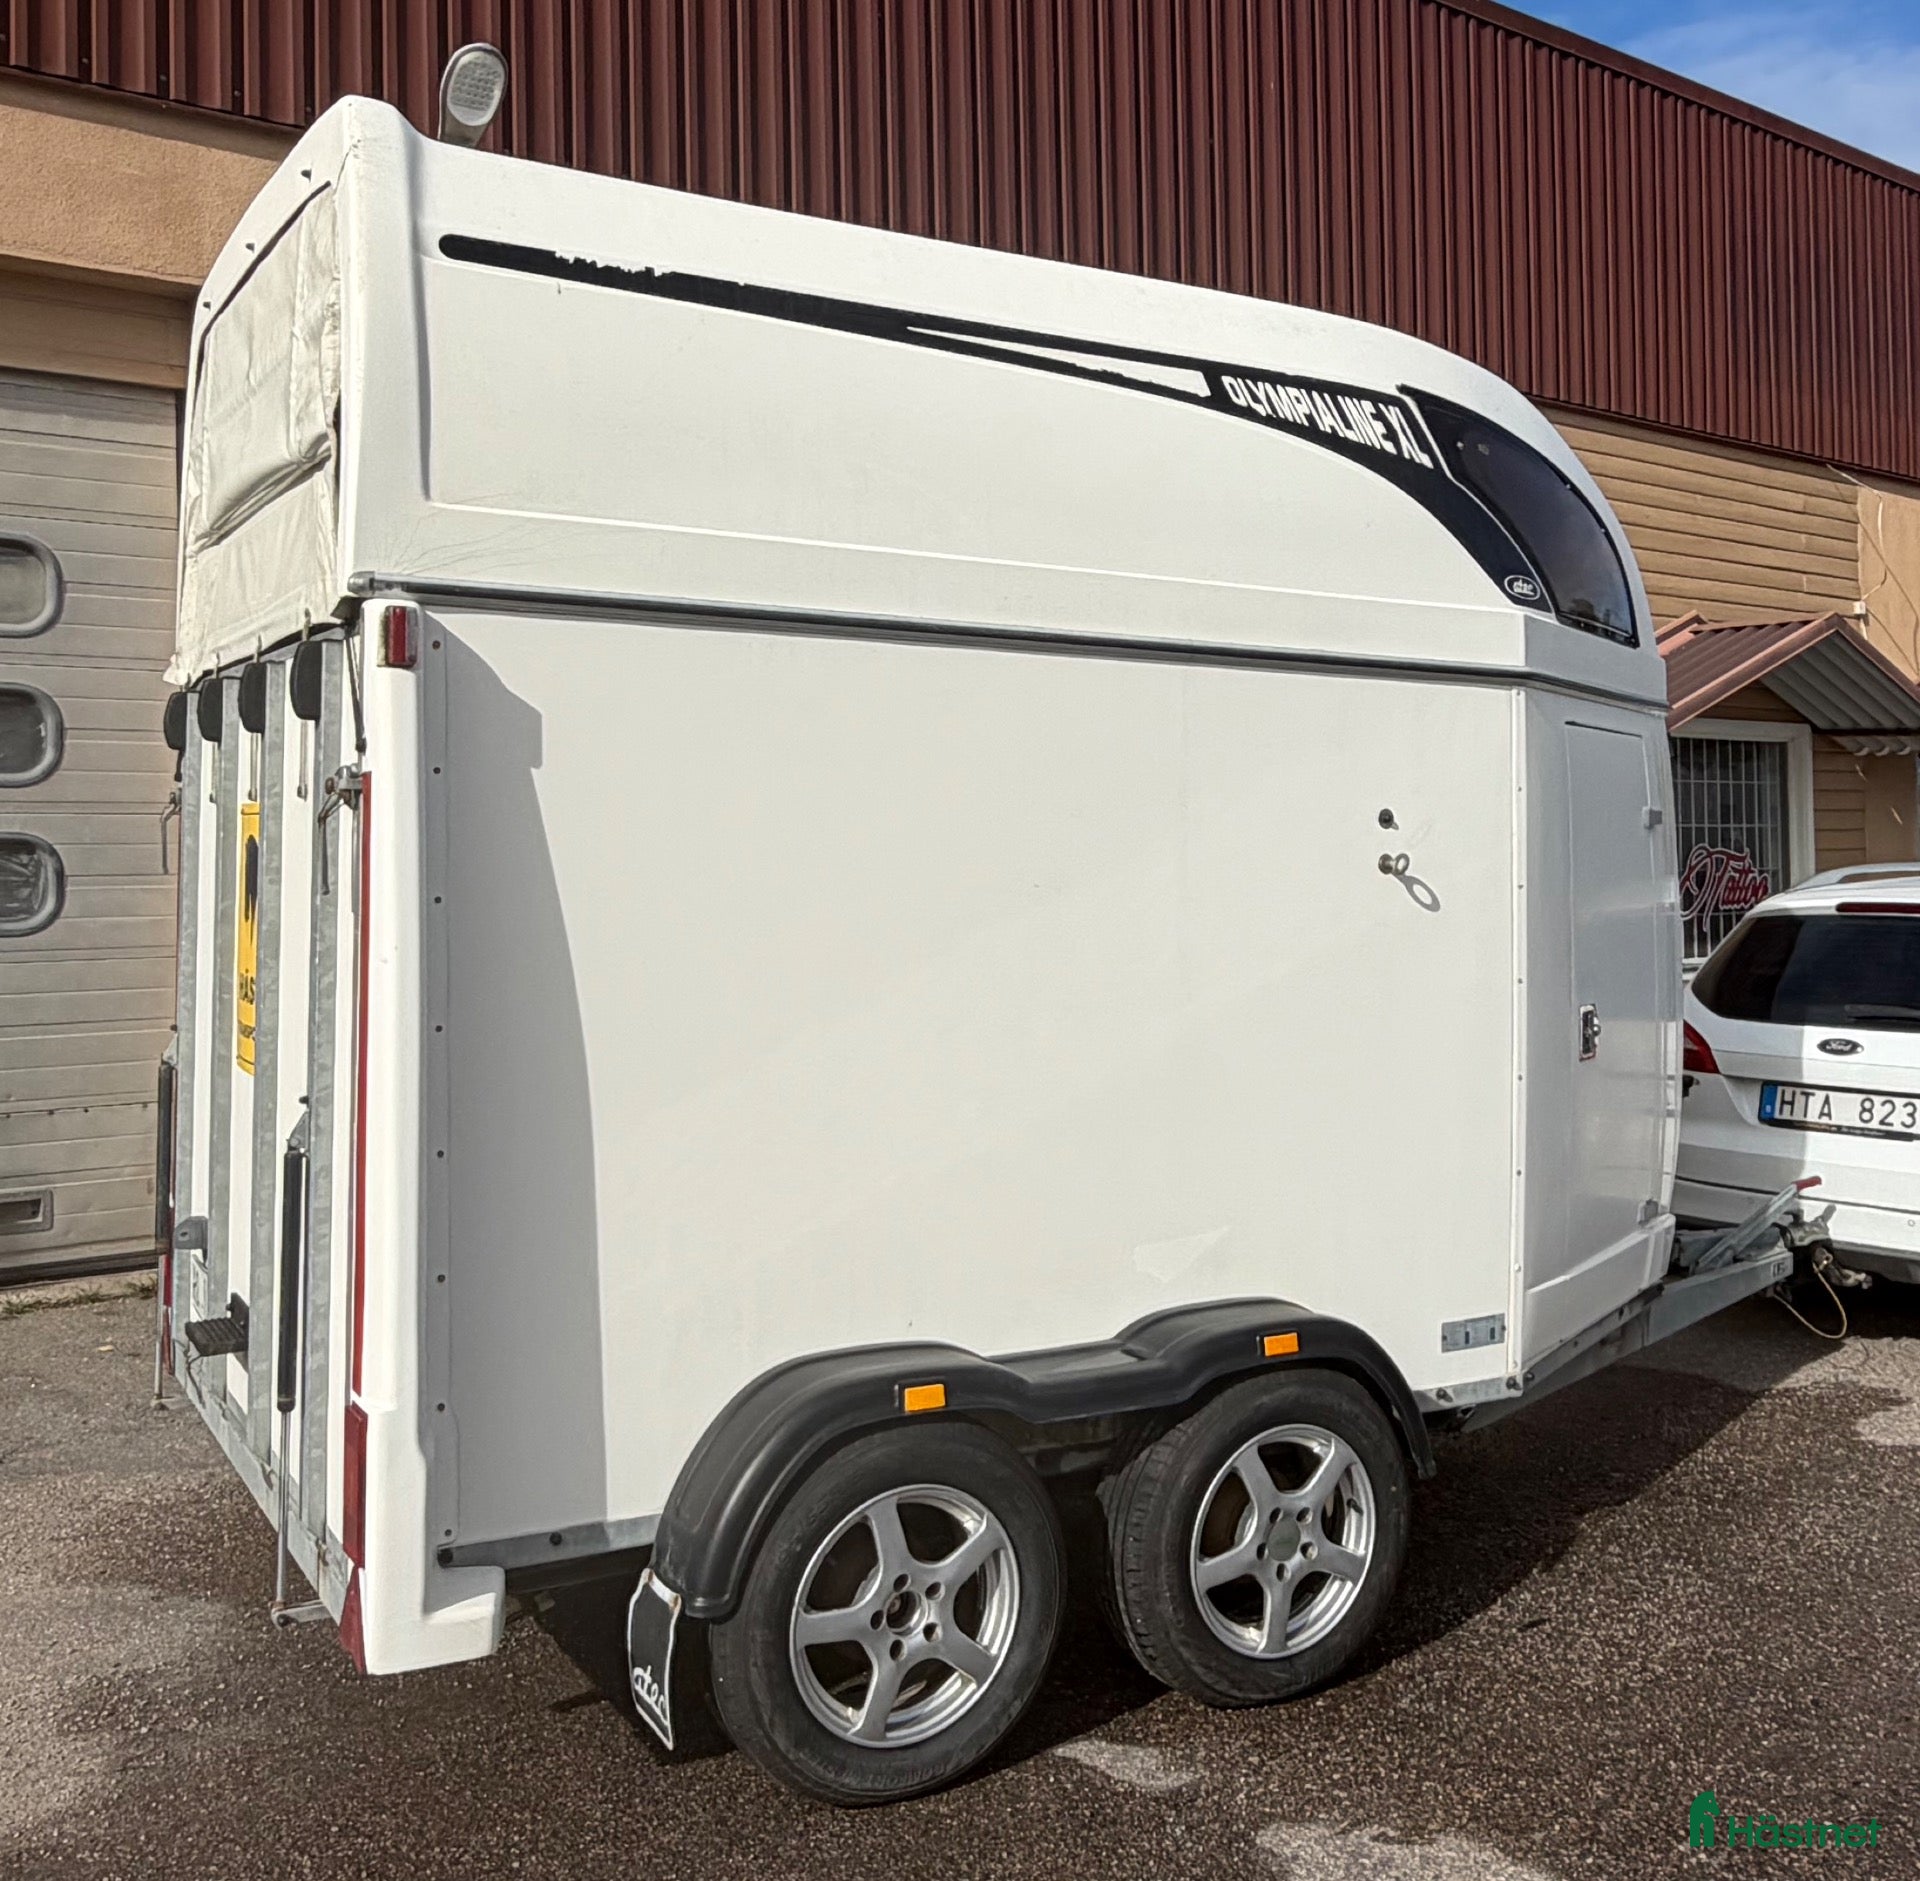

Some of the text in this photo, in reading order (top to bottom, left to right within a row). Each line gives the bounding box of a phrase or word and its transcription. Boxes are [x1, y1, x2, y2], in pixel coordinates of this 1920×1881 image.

[1221, 375, 1434, 469] OLYMPIALINE XL
[1826, 1040, 1852, 1052] Ford
[1779, 1089, 1833, 1121] HTA
[1858, 1097, 1918, 1129] 823
